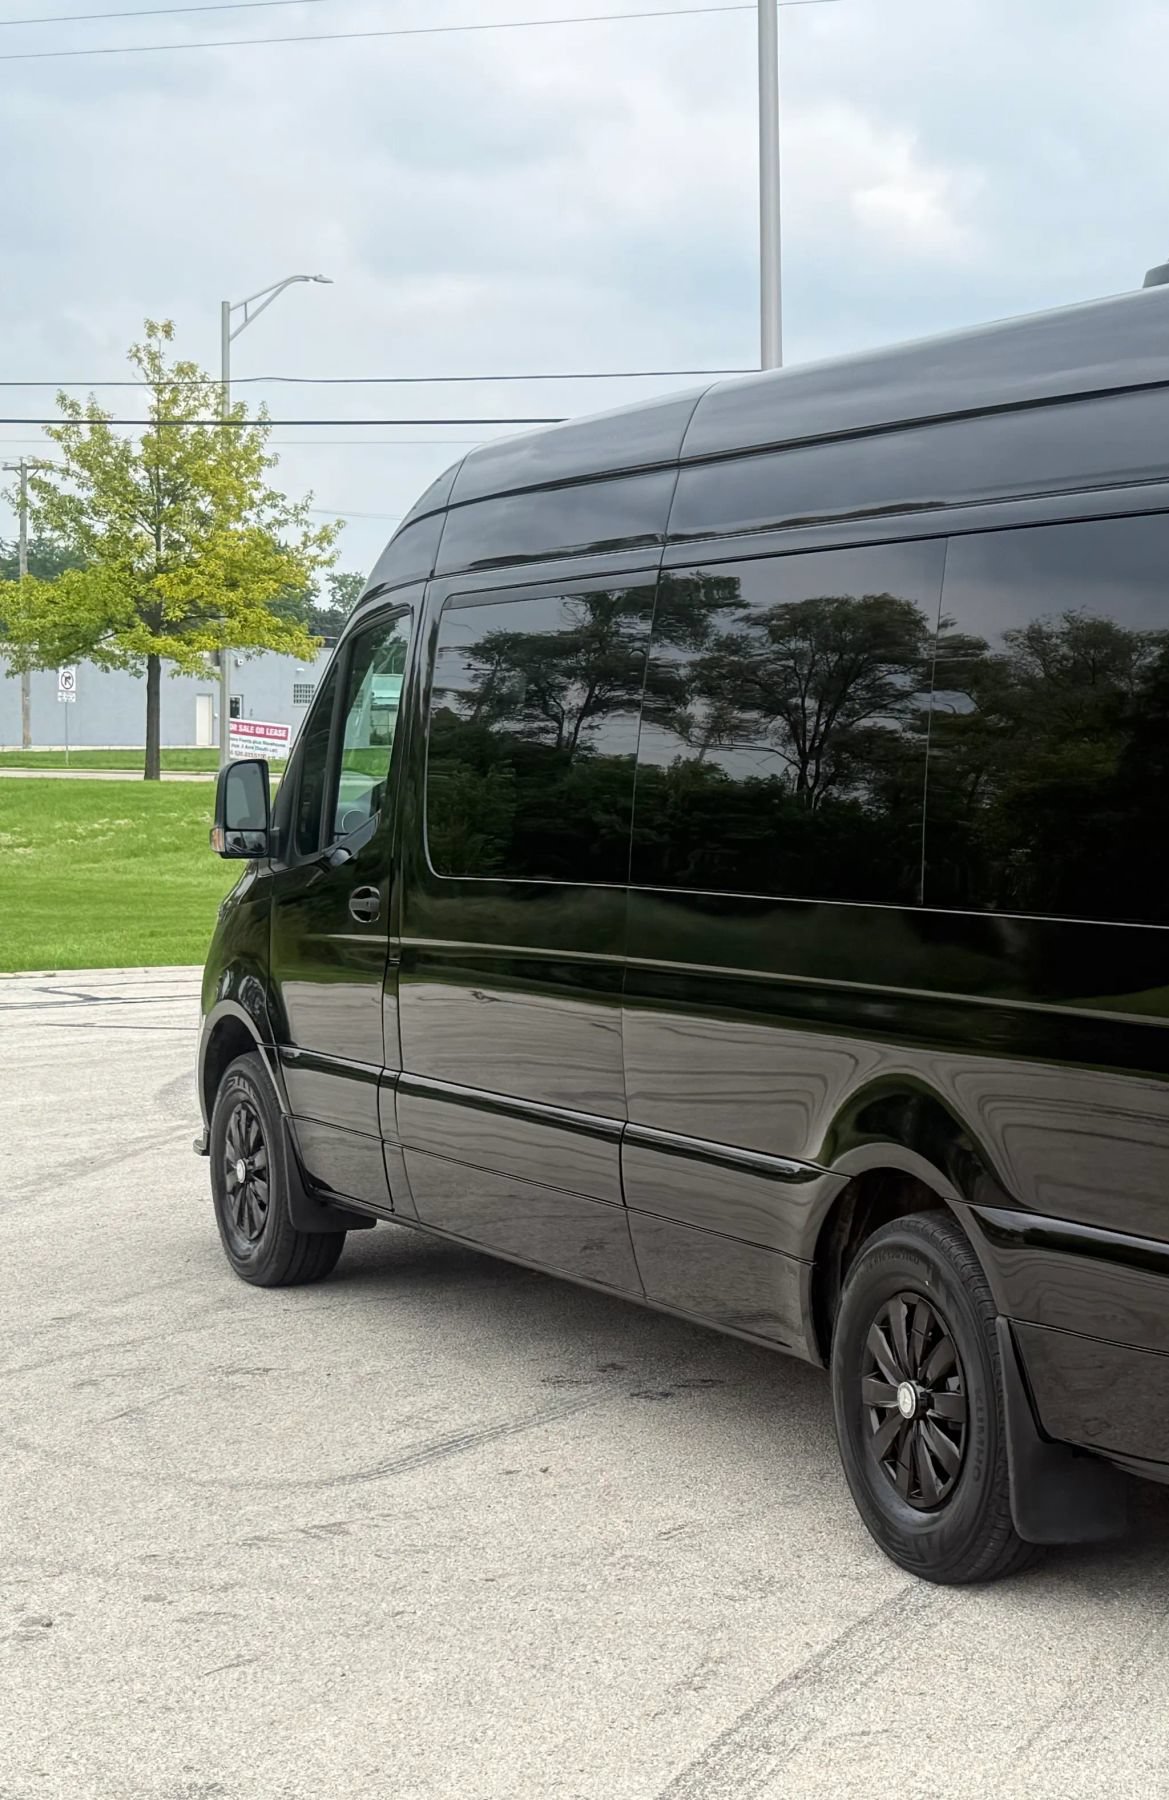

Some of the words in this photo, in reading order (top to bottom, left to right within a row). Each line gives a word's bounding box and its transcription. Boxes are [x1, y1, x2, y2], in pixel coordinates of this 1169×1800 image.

[238, 724, 255, 733] SALE
[255, 726, 265, 735] OR
[266, 728, 287, 737] LEASE
